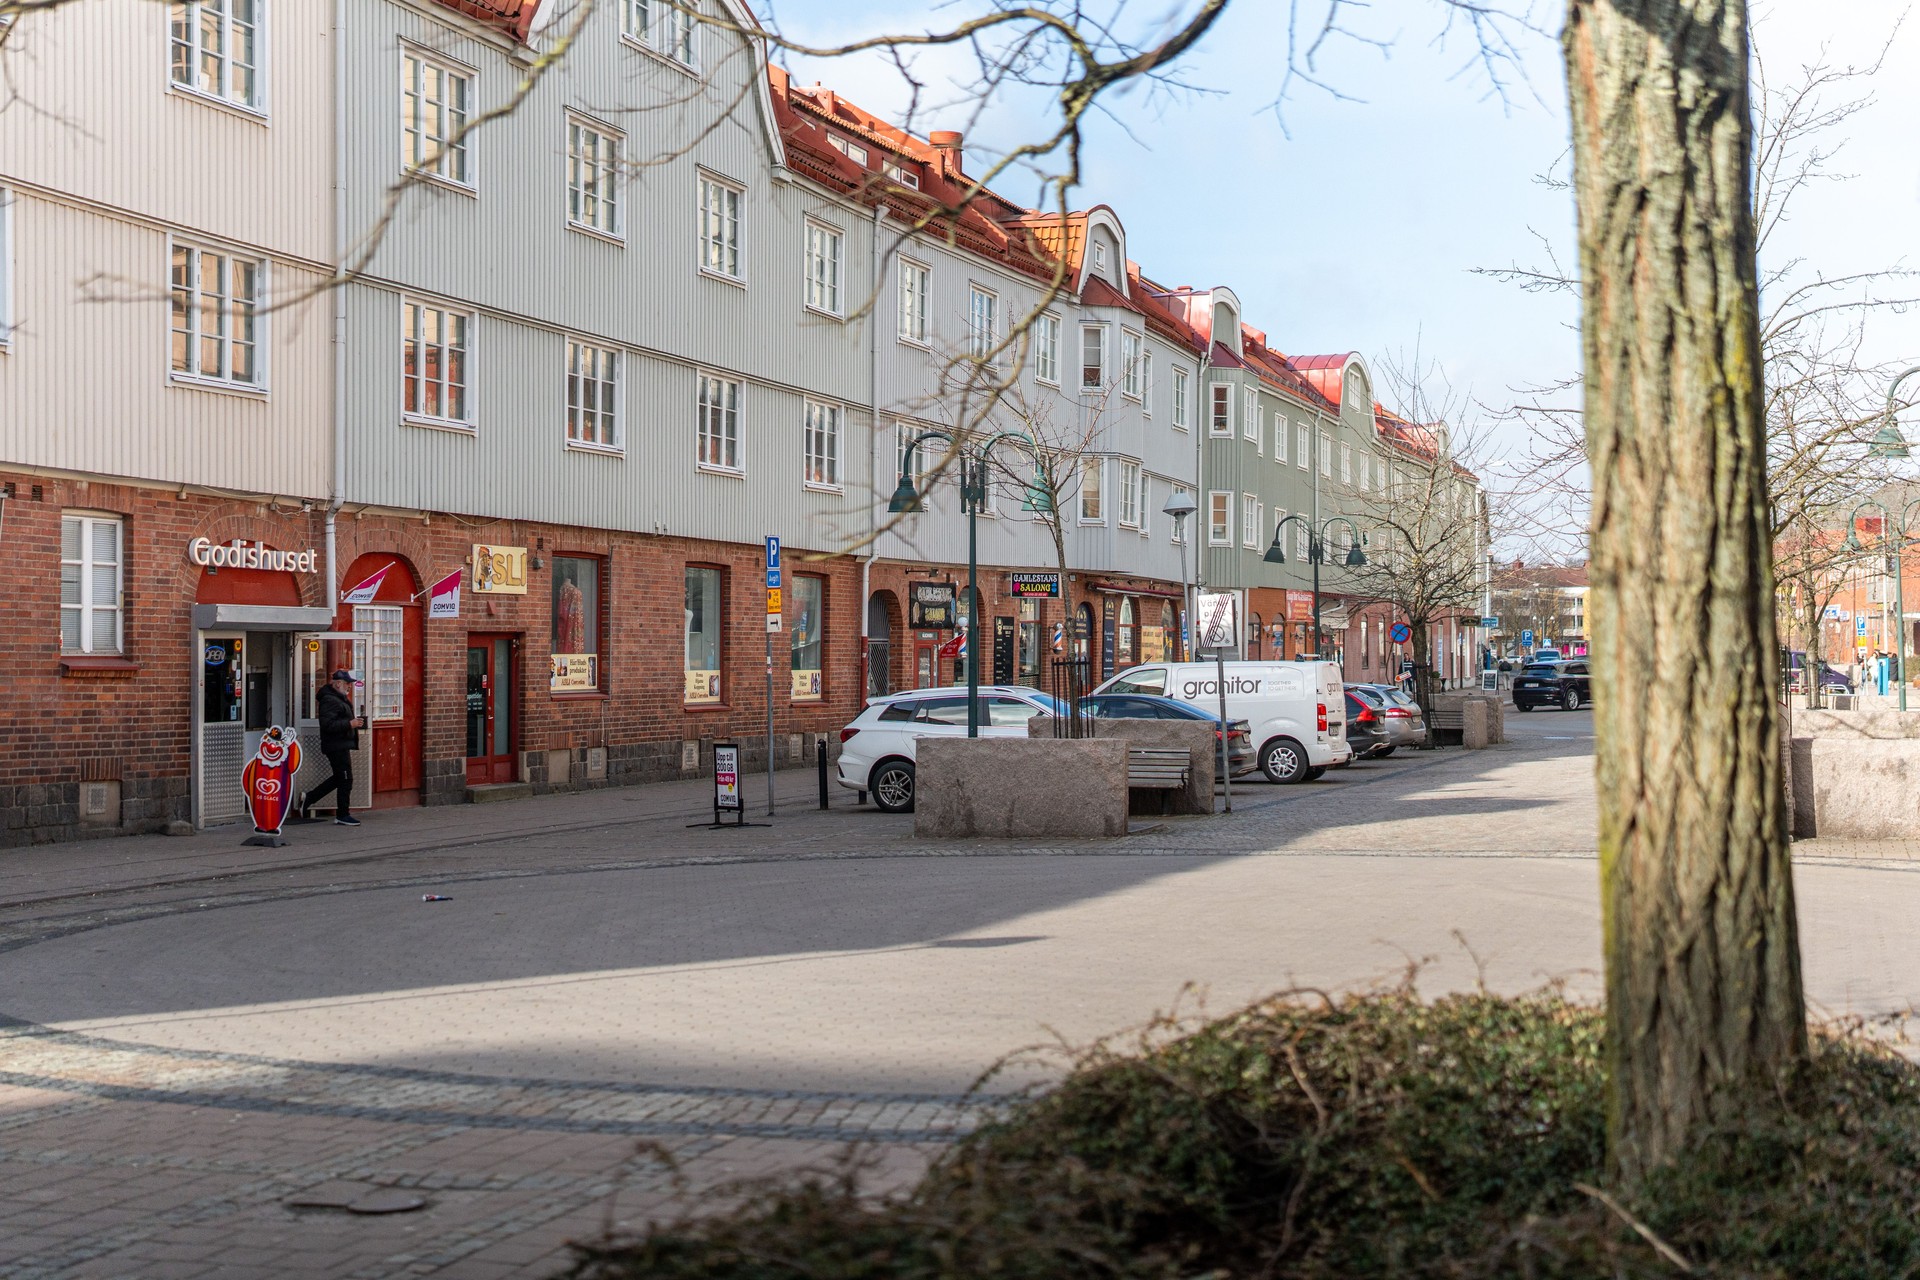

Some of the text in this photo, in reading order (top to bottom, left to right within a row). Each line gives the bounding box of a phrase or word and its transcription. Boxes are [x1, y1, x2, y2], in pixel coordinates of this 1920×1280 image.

[190, 537, 318, 573] Godishuset
[771, 540, 777, 565] P
[1013, 574, 1058, 583] GAMLESTANS
[1020, 583, 1050, 592] SALONG
[1183, 676, 1262, 699] granitor
[717, 752, 726, 762] Upp
[717, 763, 734, 772] 200 GB
